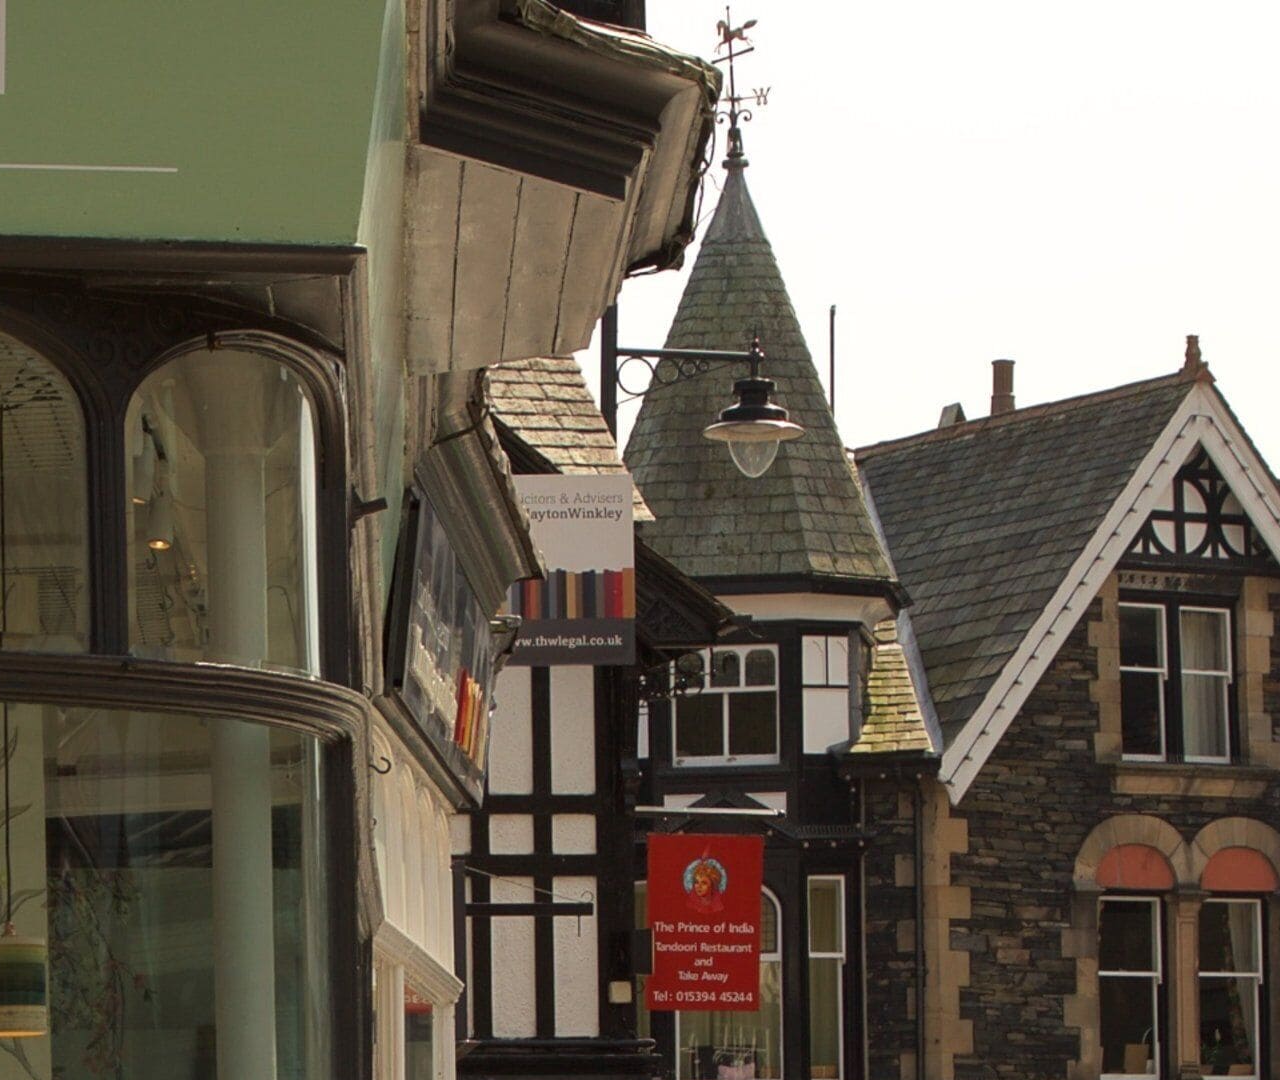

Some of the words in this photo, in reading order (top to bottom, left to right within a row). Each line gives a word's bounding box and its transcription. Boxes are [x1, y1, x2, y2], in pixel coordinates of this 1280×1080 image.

[560, 493, 570, 504] &
[573, 492, 623, 504] Advisers
[527, 507, 623, 522] aytonWinkley
[654, 921, 674, 933] The
[677, 922, 711, 933] Prince
[713, 922, 726, 933] of
[729, 923, 755, 934] India
[655, 942, 697, 952] Tandoori
[700, 942, 753, 953] Restaurant
[694, 957, 713, 967] and
[678, 971, 699, 981] Take
[701, 971, 729, 983] Away
[676, 991, 716, 1002] 015394
